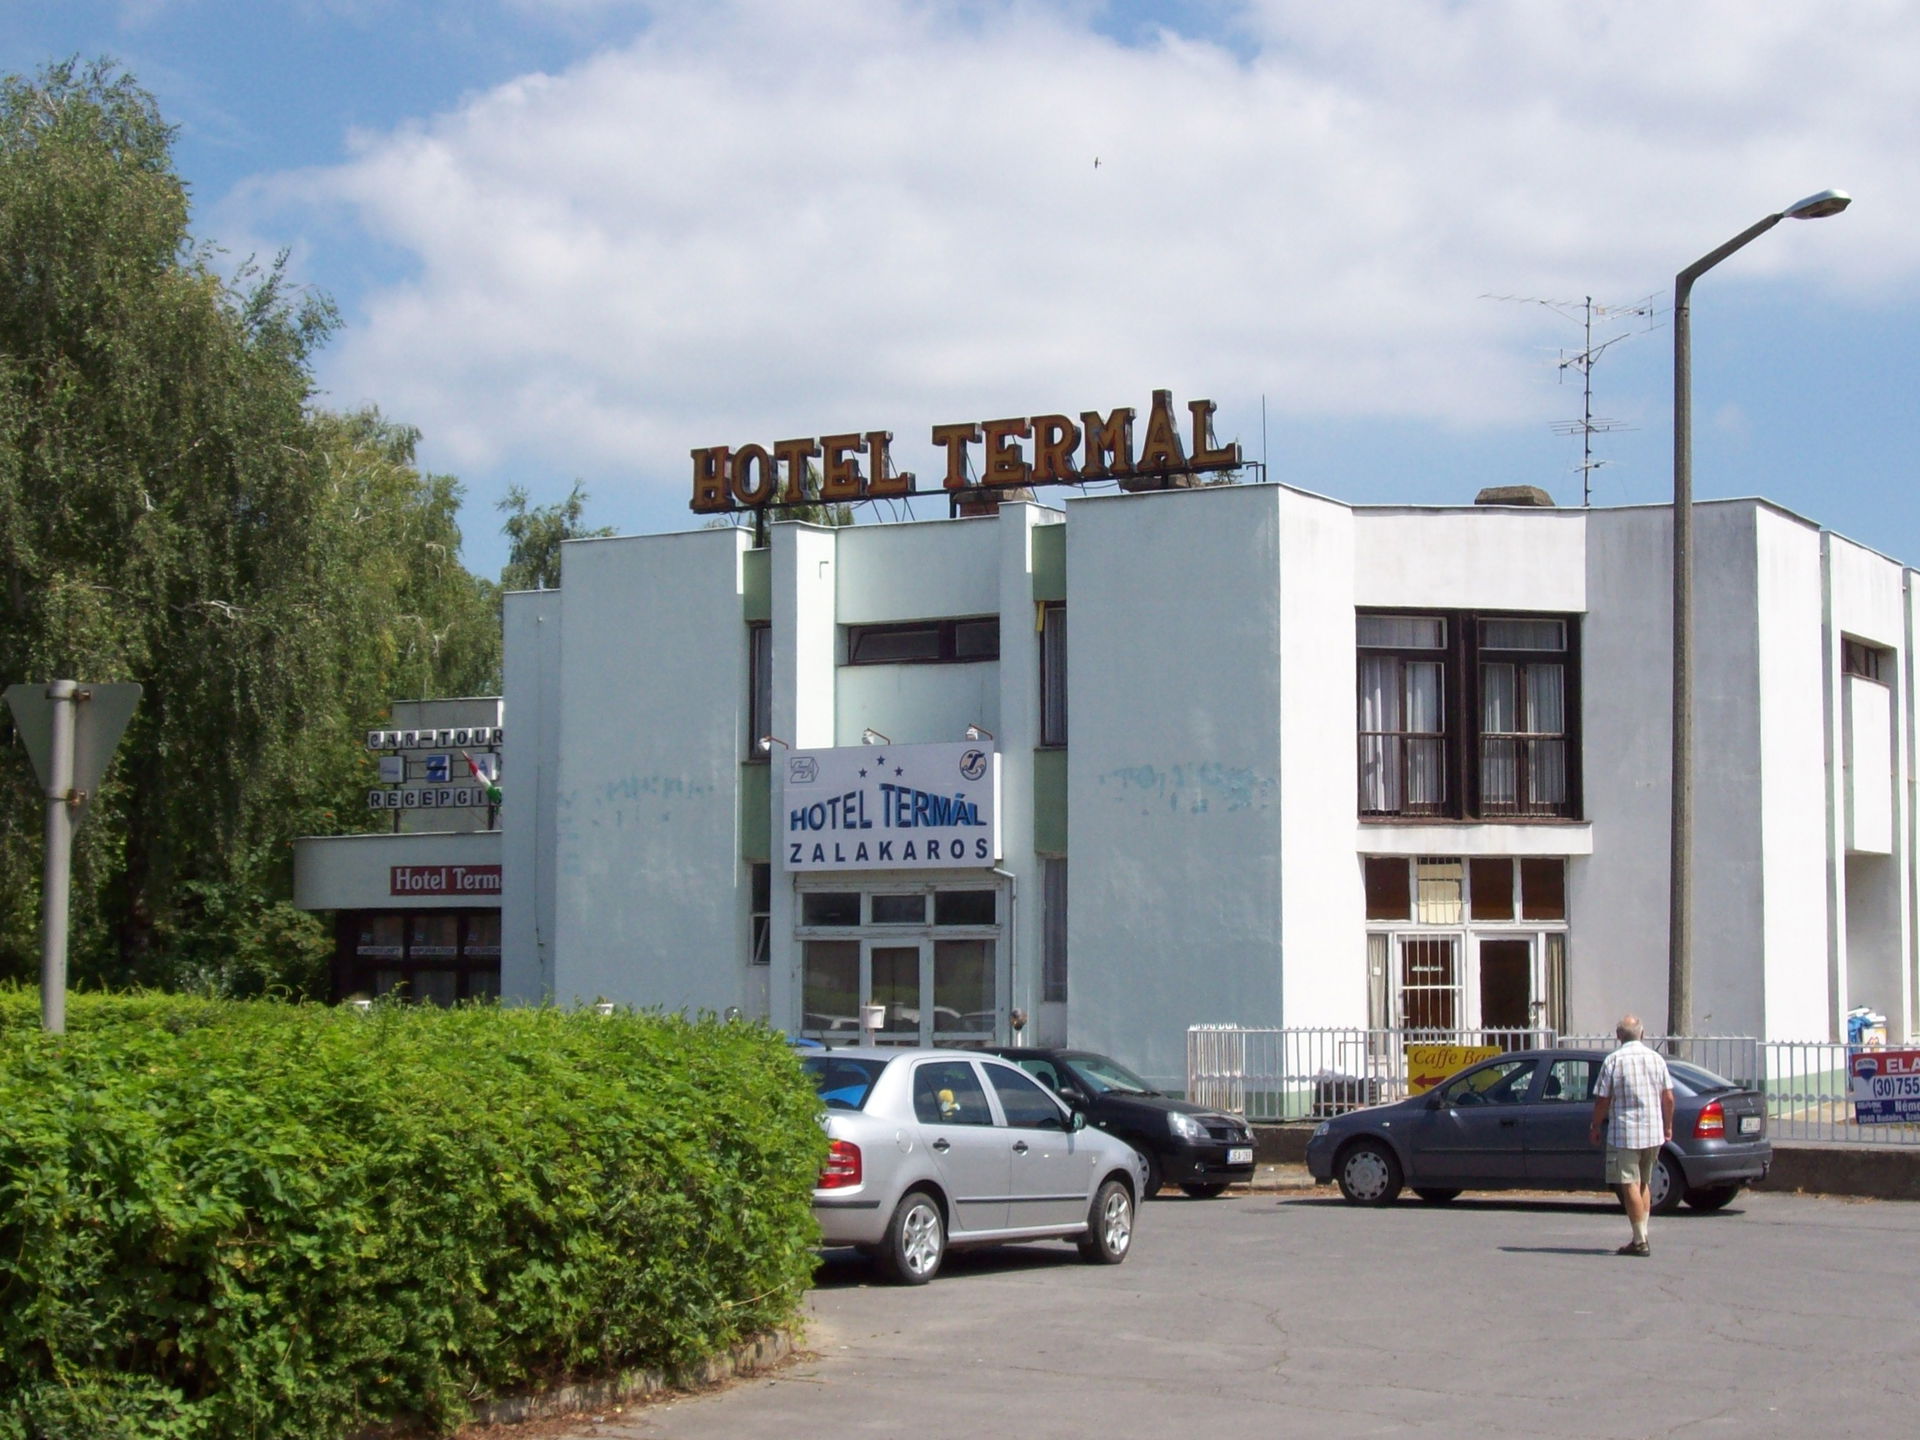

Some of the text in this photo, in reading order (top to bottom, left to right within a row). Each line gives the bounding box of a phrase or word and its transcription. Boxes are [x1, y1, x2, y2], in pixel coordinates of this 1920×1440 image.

[690, 431, 915, 513] HOTEL
[370, 730, 503, 747] CAR-TOUR
[370, 788, 502, 808] RECEPCI
[790, 783, 987, 831] HOTEL TERMÁL
[790, 838, 988, 863] ZALAKAROS
[396, 867, 502, 890] Hotel Term
[1413, 1049, 1496, 1069] Caffe Ba
